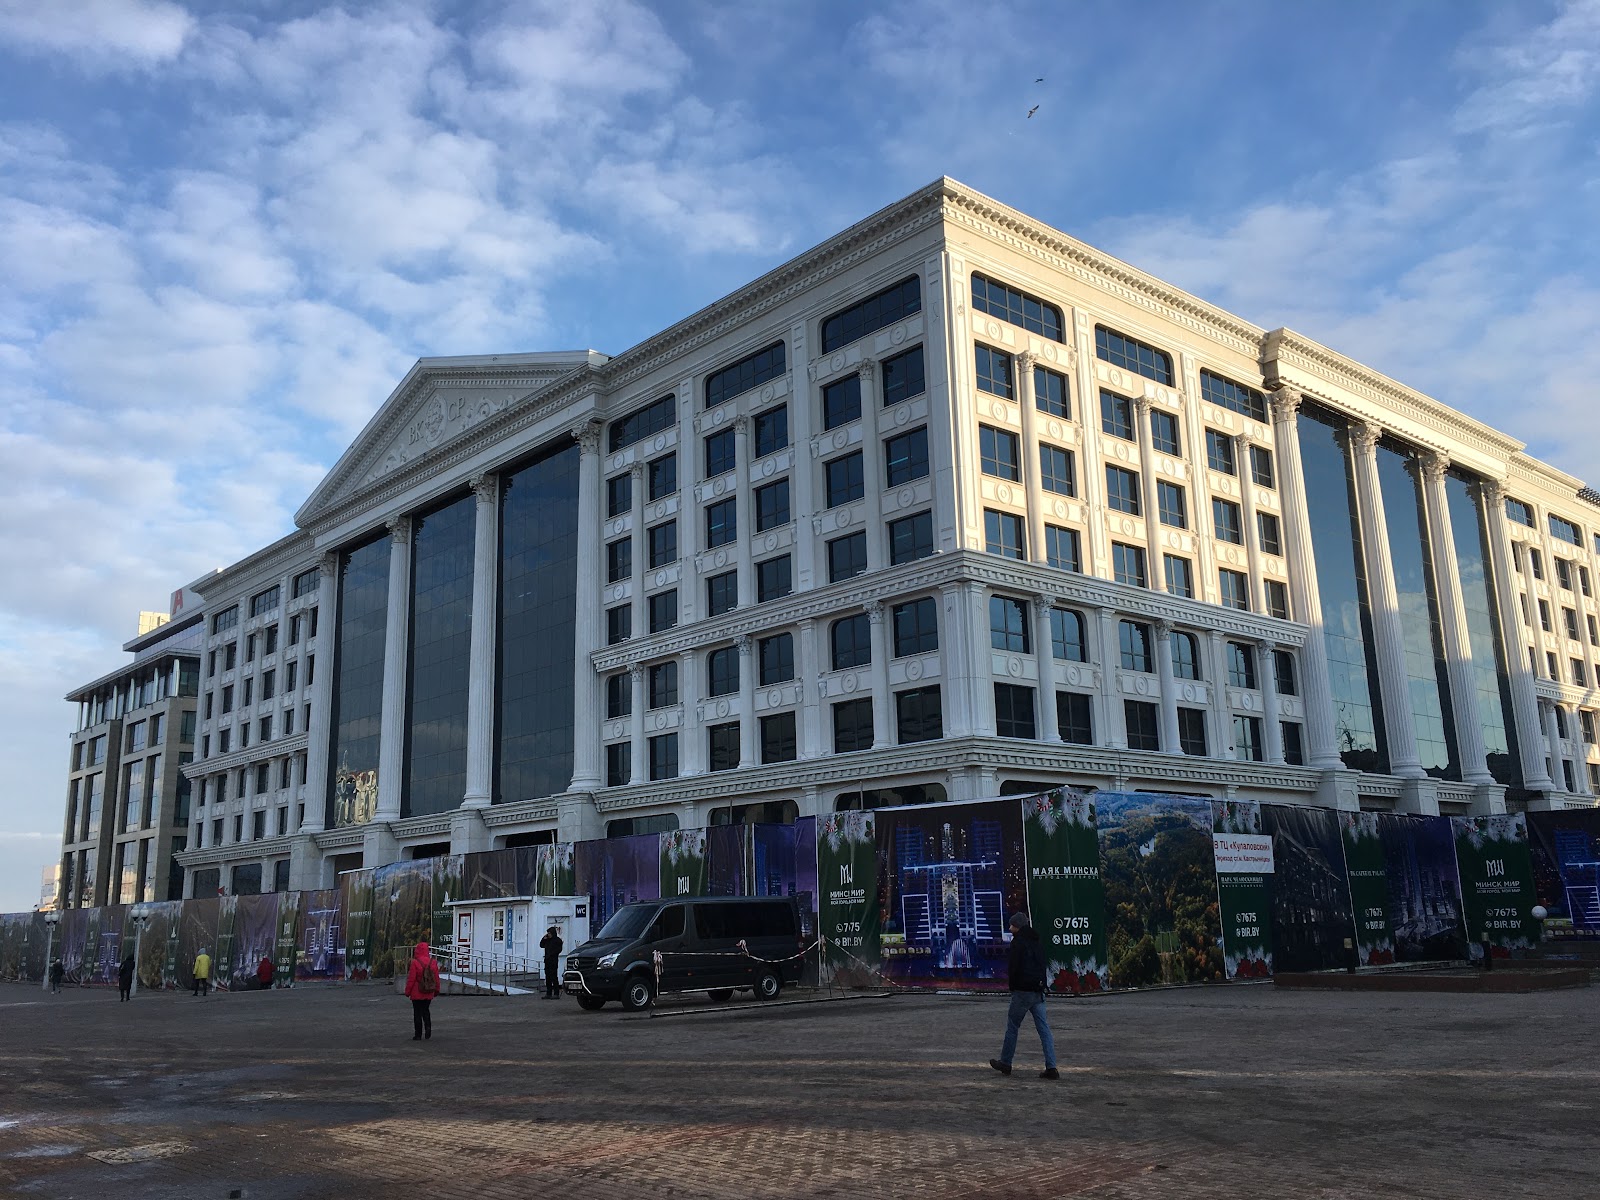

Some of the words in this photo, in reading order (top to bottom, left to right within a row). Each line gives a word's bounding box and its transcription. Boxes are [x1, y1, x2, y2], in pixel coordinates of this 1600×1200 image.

[1219, 840, 1229, 851] ТЦ
[1032, 866, 1060, 875] МАЯК
[1063, 866, 1099, 875] МИНСКА
[1475, 880, 1502, 888] МИНСК
[576, 907, 586, 915] WC
[1493, 908, 1518, 917] 7675
[1241, 912, 1257, 923] 7675
[1063, 917, 1089, 929] 7675
[1493, 919, 1522, 929] BIR.BY
[1241, 926, 1260, 937] BIR.BY
[1062, 933, 1093, 945] BIR.BY
